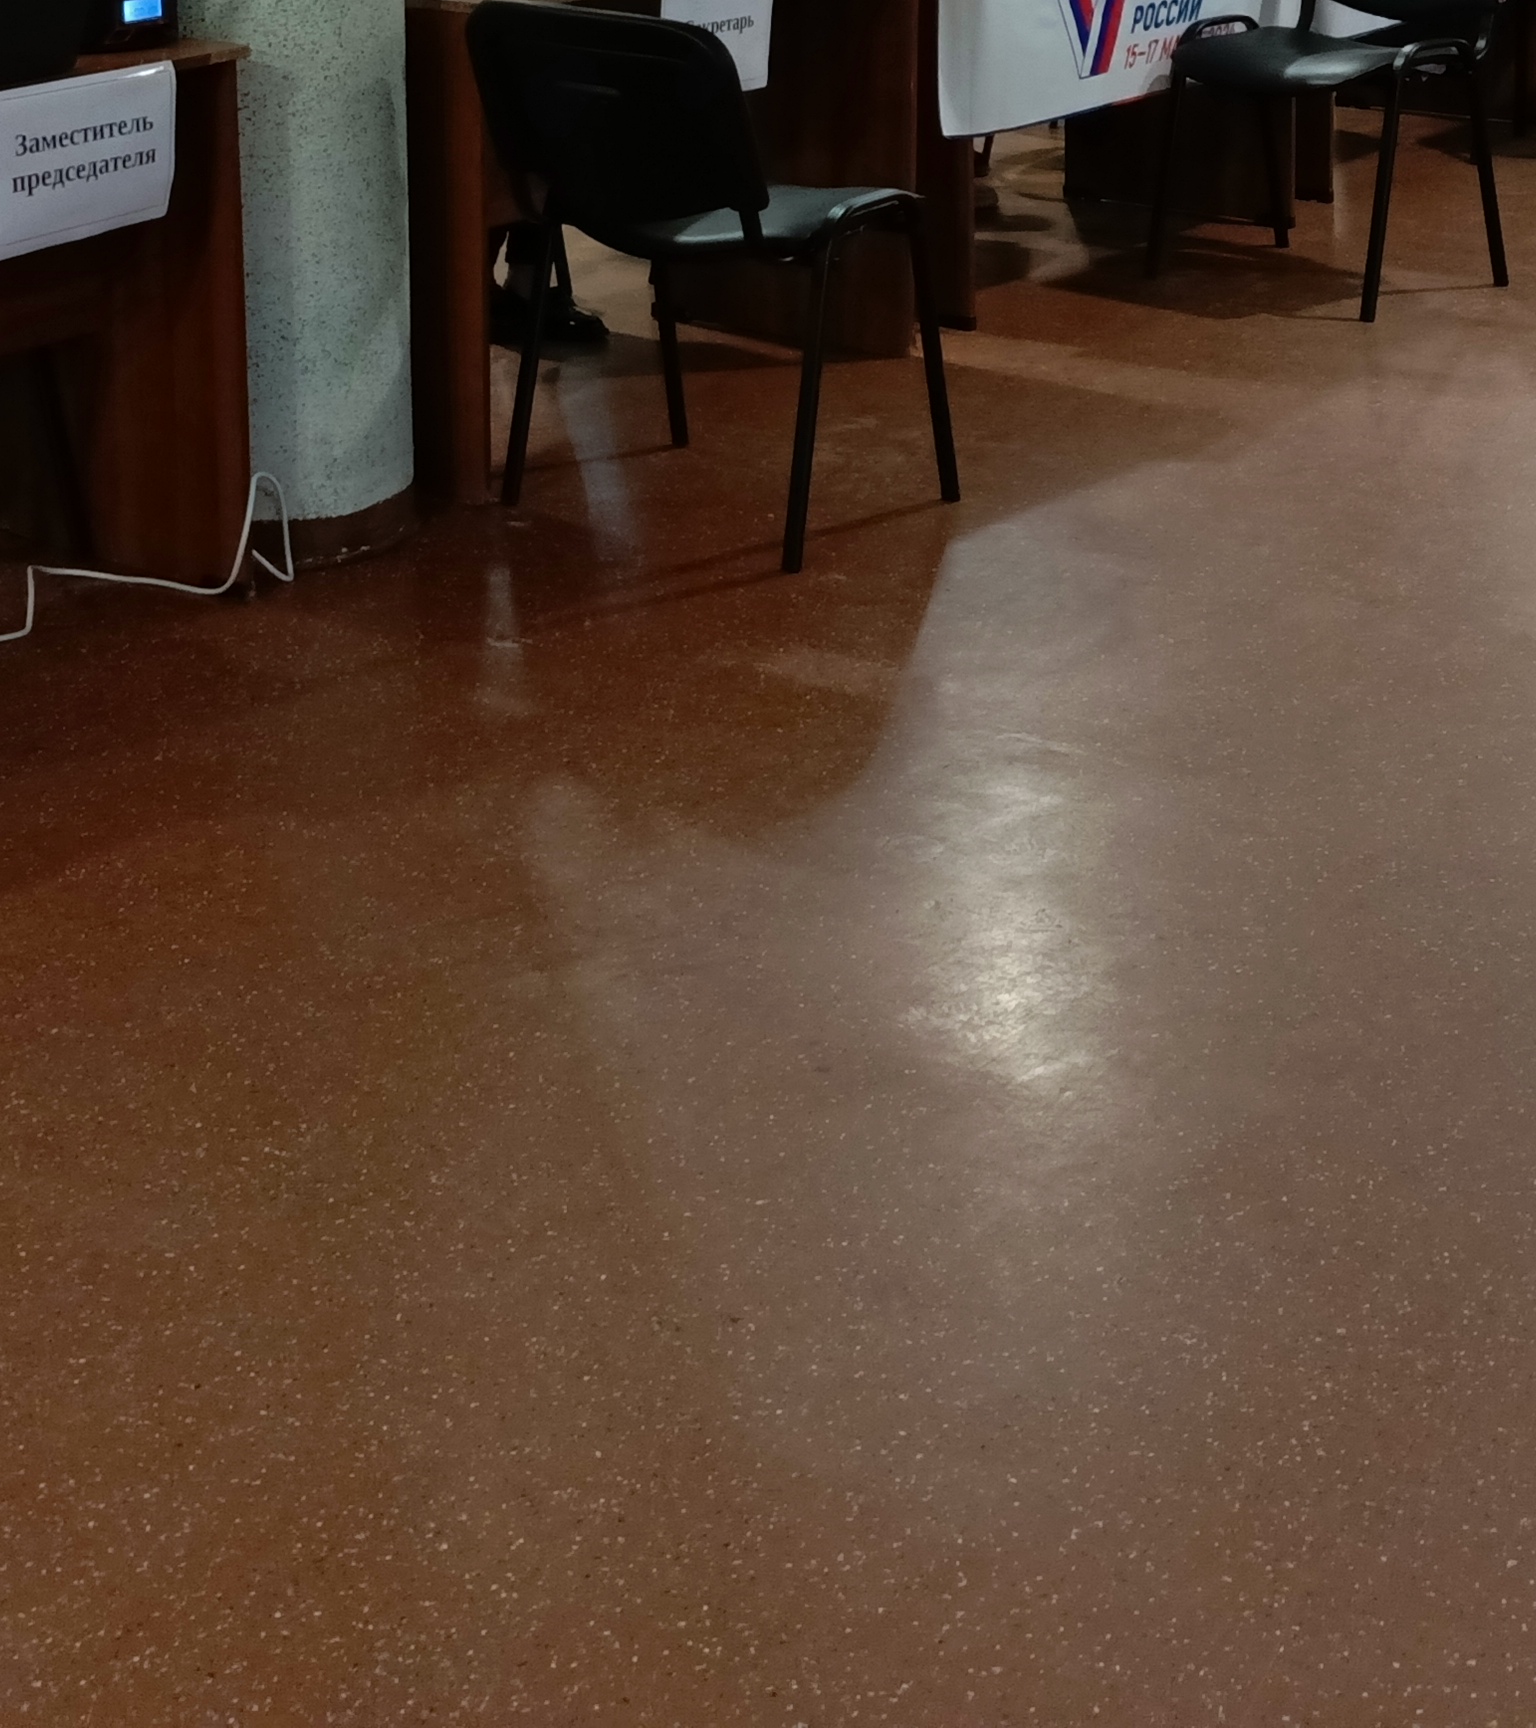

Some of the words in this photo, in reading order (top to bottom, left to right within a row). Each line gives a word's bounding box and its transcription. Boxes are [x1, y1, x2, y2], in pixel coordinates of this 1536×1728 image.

[686, 15, 755, 35] кретарь
[15, 116, 154, 157] Заместитель
[11, 147, 157, 198] председателя
